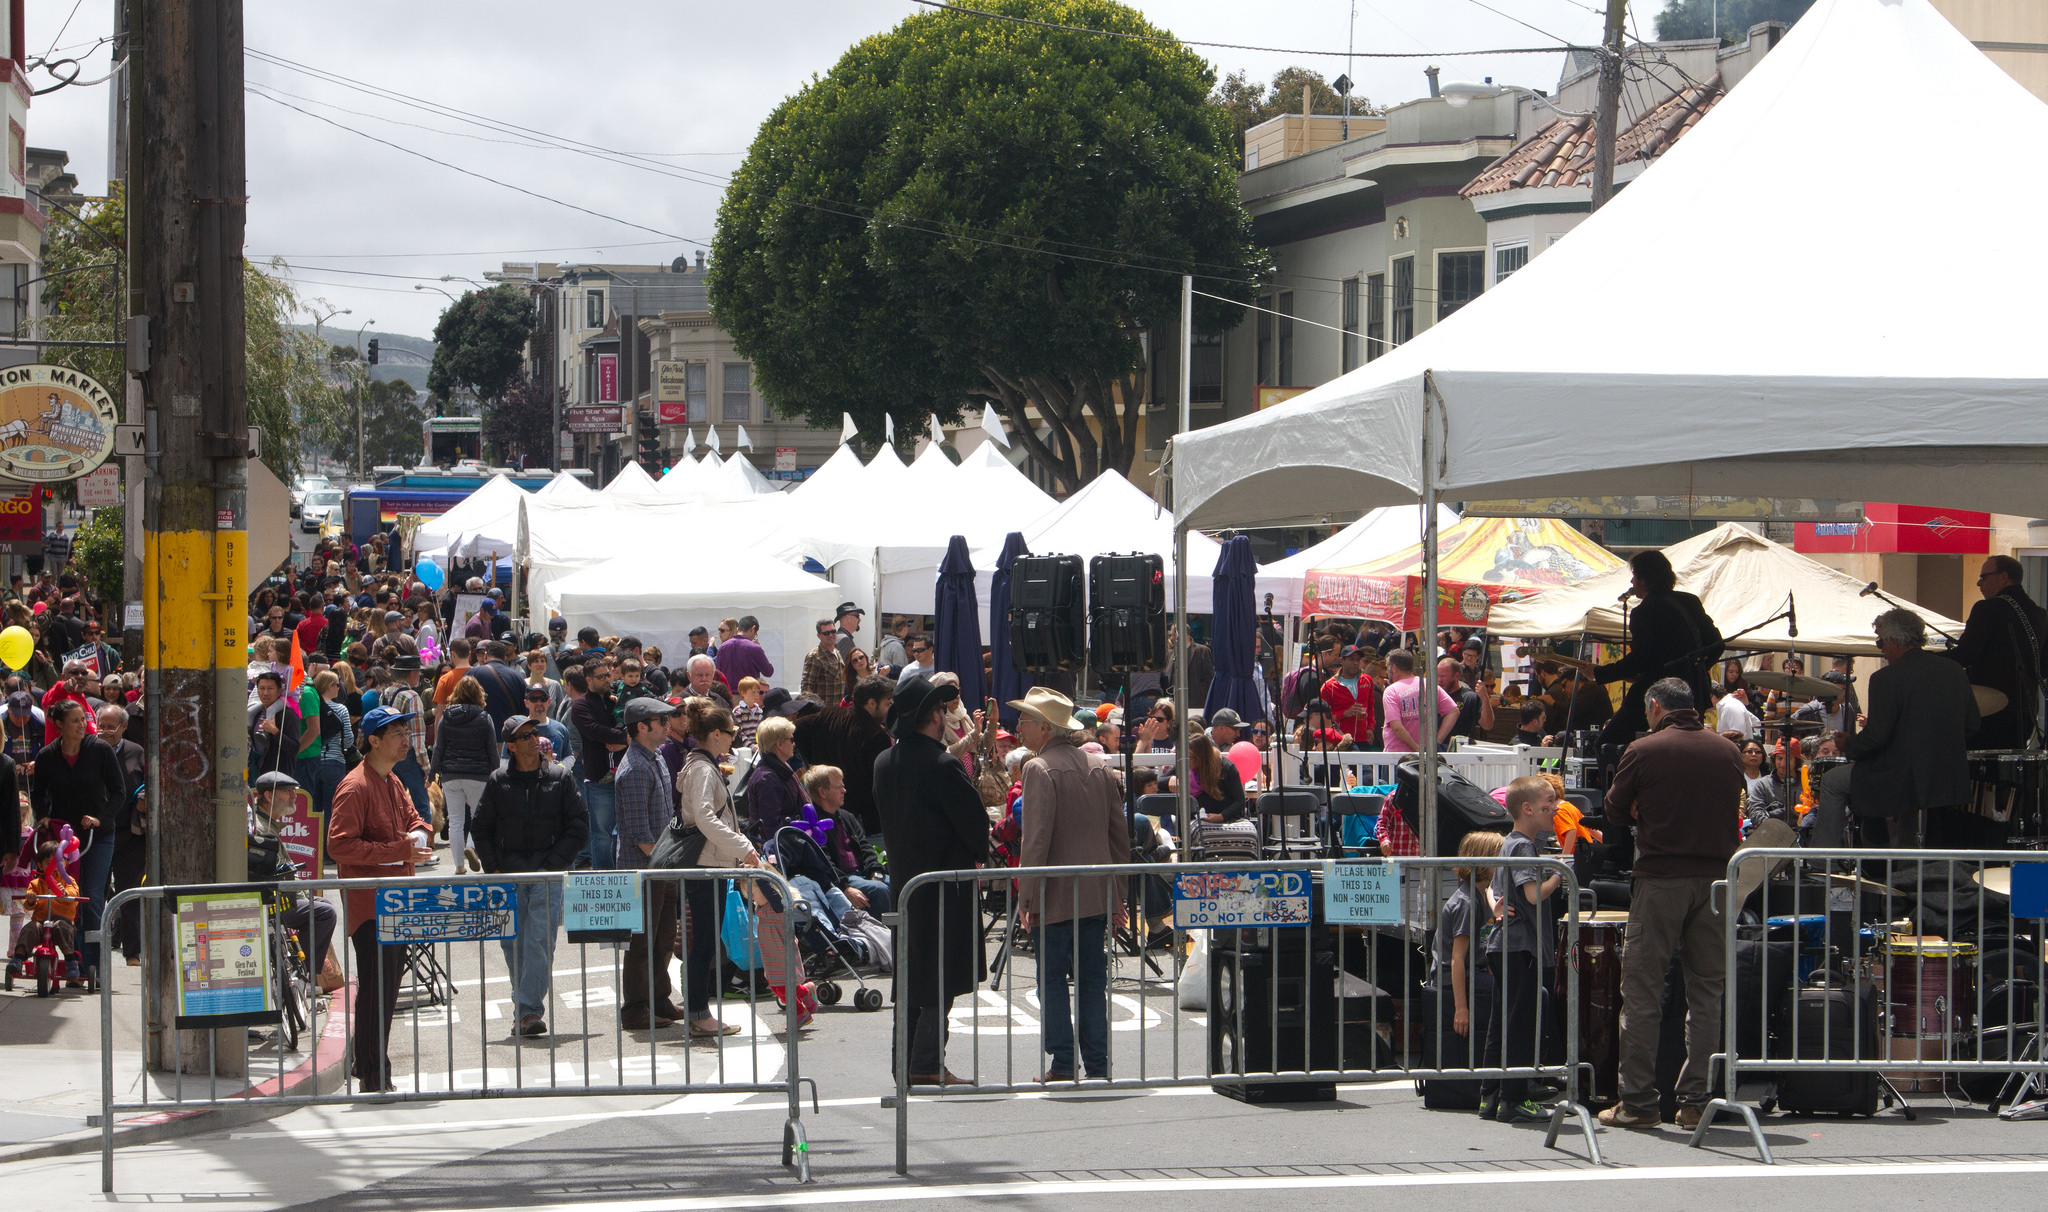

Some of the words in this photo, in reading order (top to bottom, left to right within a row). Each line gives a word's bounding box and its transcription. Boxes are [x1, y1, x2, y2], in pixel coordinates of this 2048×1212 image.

[50, 369, 114, 421] MARKET
[14, 467, 39, 478] VILLAGE
[42, 469, 67, 479] GROCER
[1317, 576, 1358, 601] MENDOCINO
[1357, 578, 1391, 604] BREWING
[224, 628, 236, 636] 36
[224, 639, 236, 647] 52
[279, 822, 310, 837] nk
[297, 871, 312, 879] EEF
[1335, 867, 1365, 876] PLEASE
[1367, 867, 1387, 876] NOTE
[575, 876, 605, 886] PLEASE
[608, 876, 628, 885] NOTE
[1341, 880, 1360, 890] THIS
[1363, 880, 1372, 890] IS
[1375, 880, 1381, 890] A
[581, 889, 601, 899] THIS
[603, 889, 613, 899] IS
[616, 889, 622, 899] A
[1349, 907, 1373, 916] EVENT
[402, 914, 451, 926] POLICE
[463, 913, 492, 924] LINE
[589, 916, 614, 925] EVENT
[1190, 913, 1208, 923] DO
[1218, 912, 1244, 922] NOT
[1253, 911, 1296, 921] CROSS
[393, 928, 412, 938] DO
[421, 926, 448, 936] NOT
[458, 925, 501, 935] CROSS
[246, 960, 257, 968] Park
